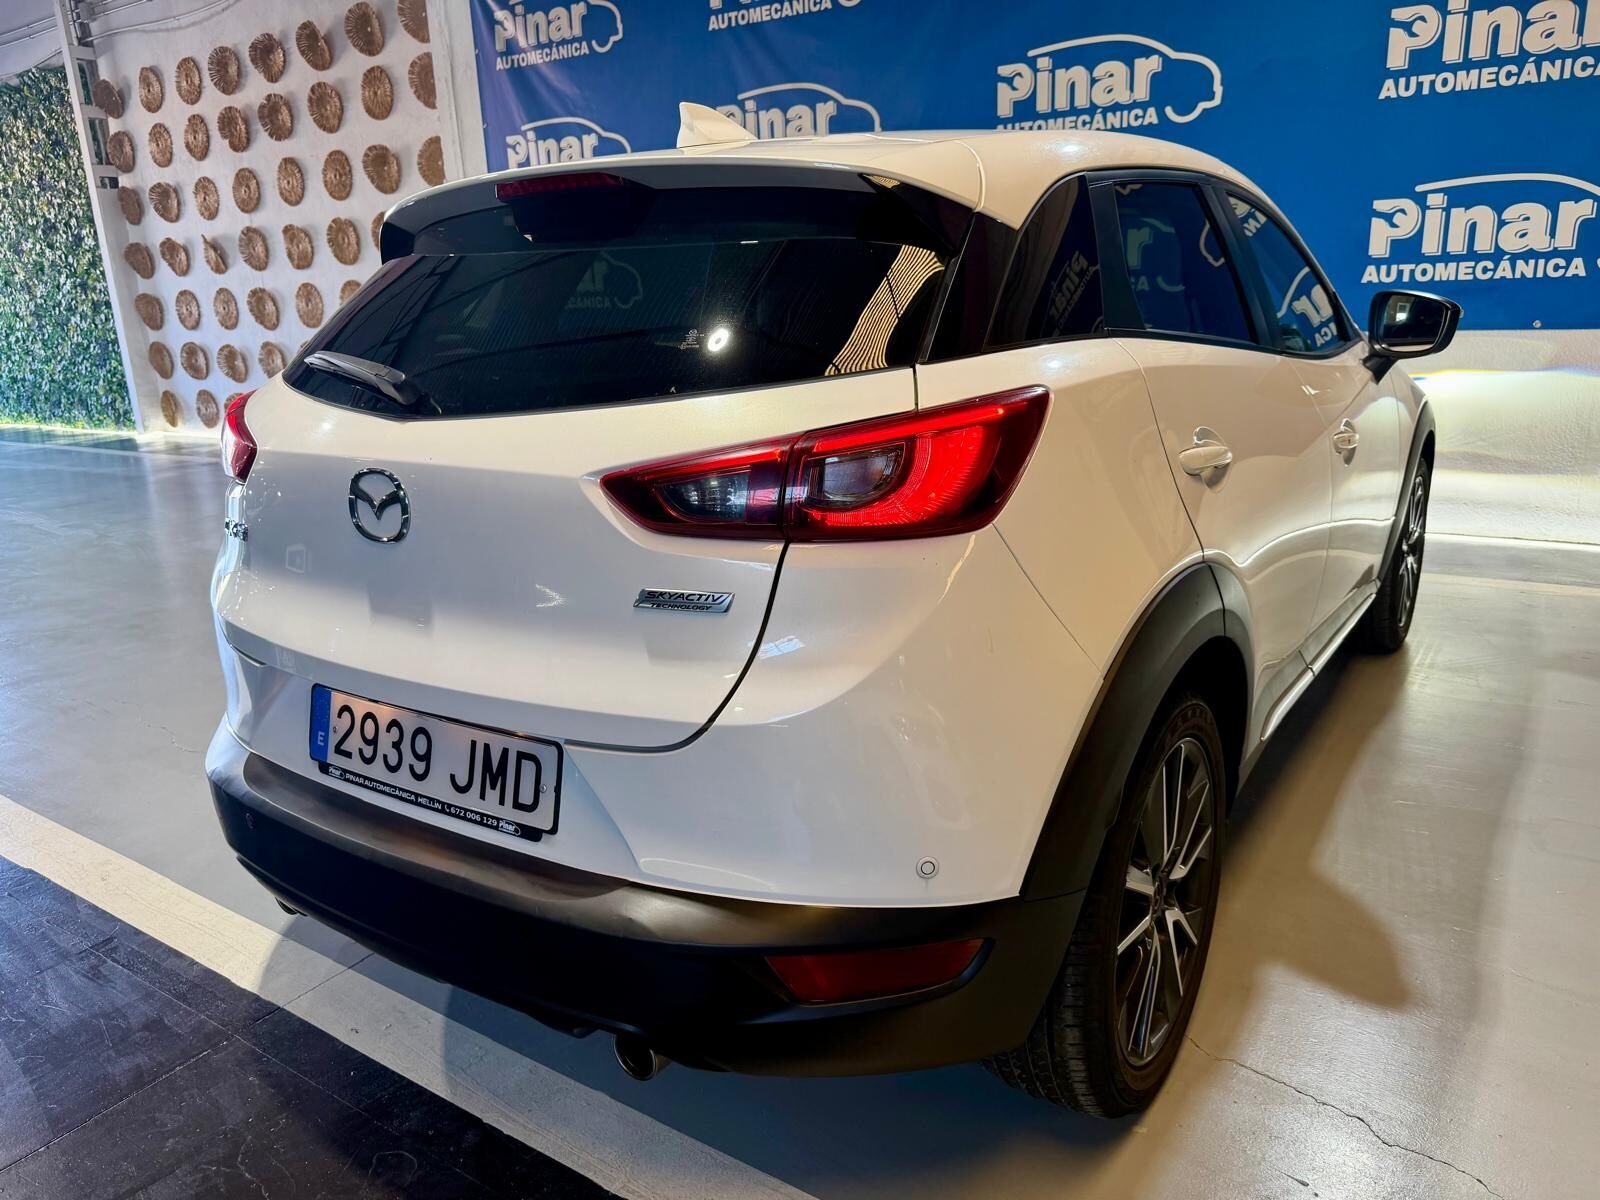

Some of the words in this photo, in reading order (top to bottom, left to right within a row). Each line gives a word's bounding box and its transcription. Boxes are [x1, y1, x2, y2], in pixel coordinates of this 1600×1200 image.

[494, 1, 588, 53] Pinar
[496, 41, 589, 71] AUTOMECÁNICA
[997, 54, 1163, 118] Pinar
[1378, 55, 1600, 100] AUTOMECÁNIC
[506, 130, 599, 169] Pinar
[1368, 192, 1598, 258] Pinar
[1360, 254, 1587, 284] AUTOMECÁNICA
[644, 591, 724, 603] SKYACTIV
[650, 602, 712, 611] TECHNOLOGY
[317, 731, 325, 746] E
[333, 704, 433, 782] 2939
[449, 739, 543, 813] JMD
[345, 773, 364, 785] PINAR
[450, 806, 465, 817] 672
[466, 811, 481, 822] 006
[483, 816, 498, 827] 129
